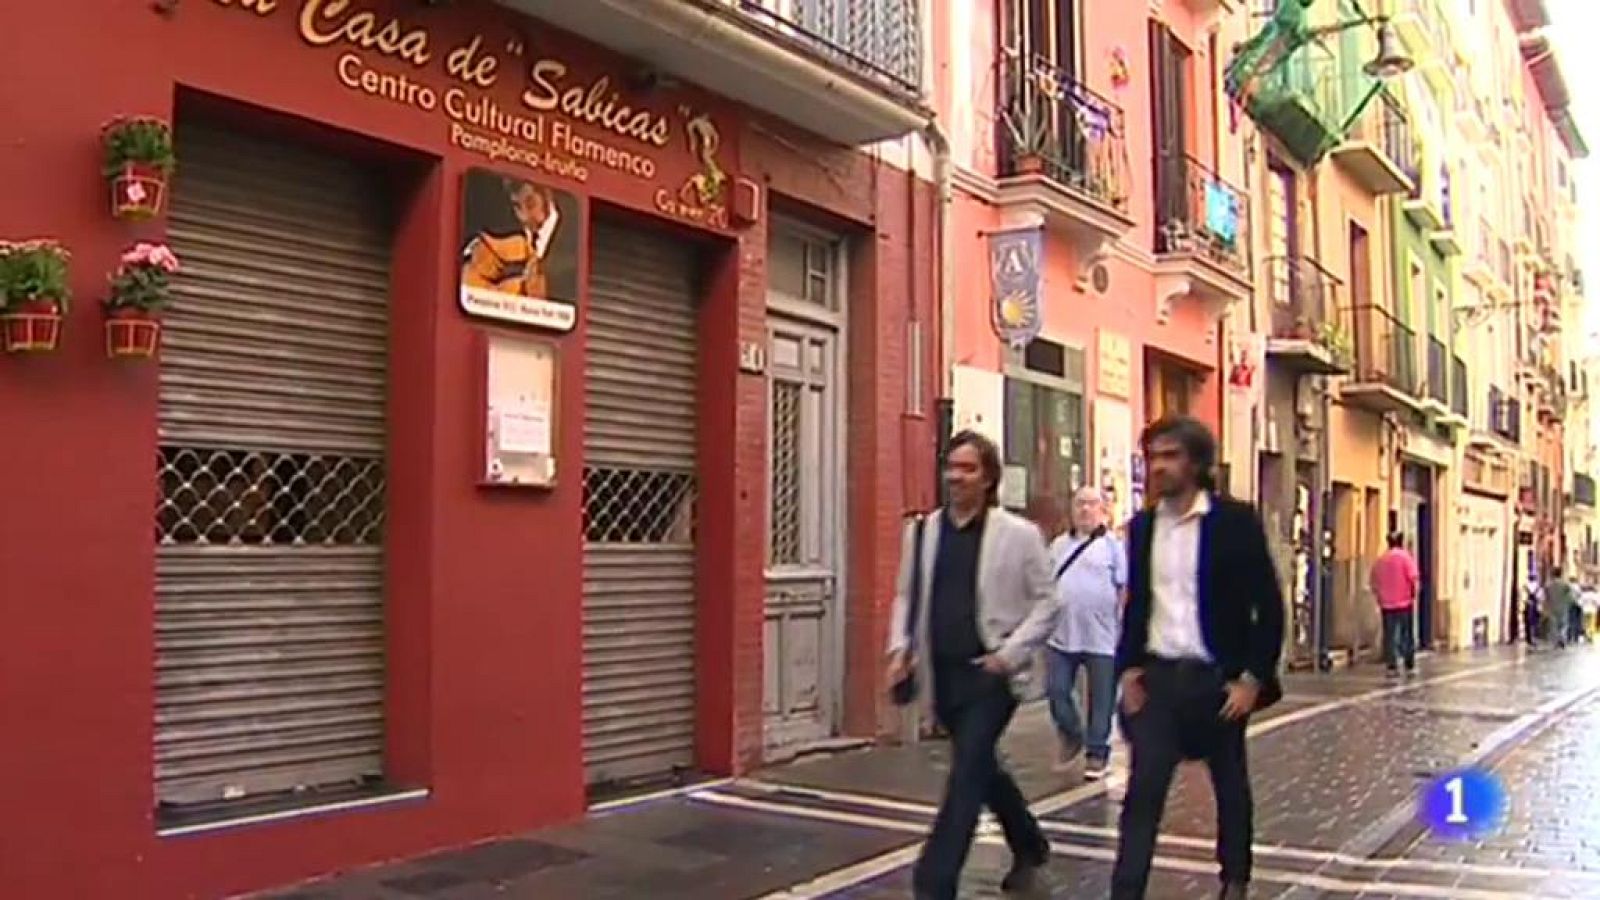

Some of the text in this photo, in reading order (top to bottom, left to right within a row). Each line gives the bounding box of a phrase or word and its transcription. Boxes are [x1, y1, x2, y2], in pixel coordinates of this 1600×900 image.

[301, 0, 431, 65] Casa
[447, 34, 498, 86] de
[338, 54, 656, 179] Centro Cultural Flamenco
